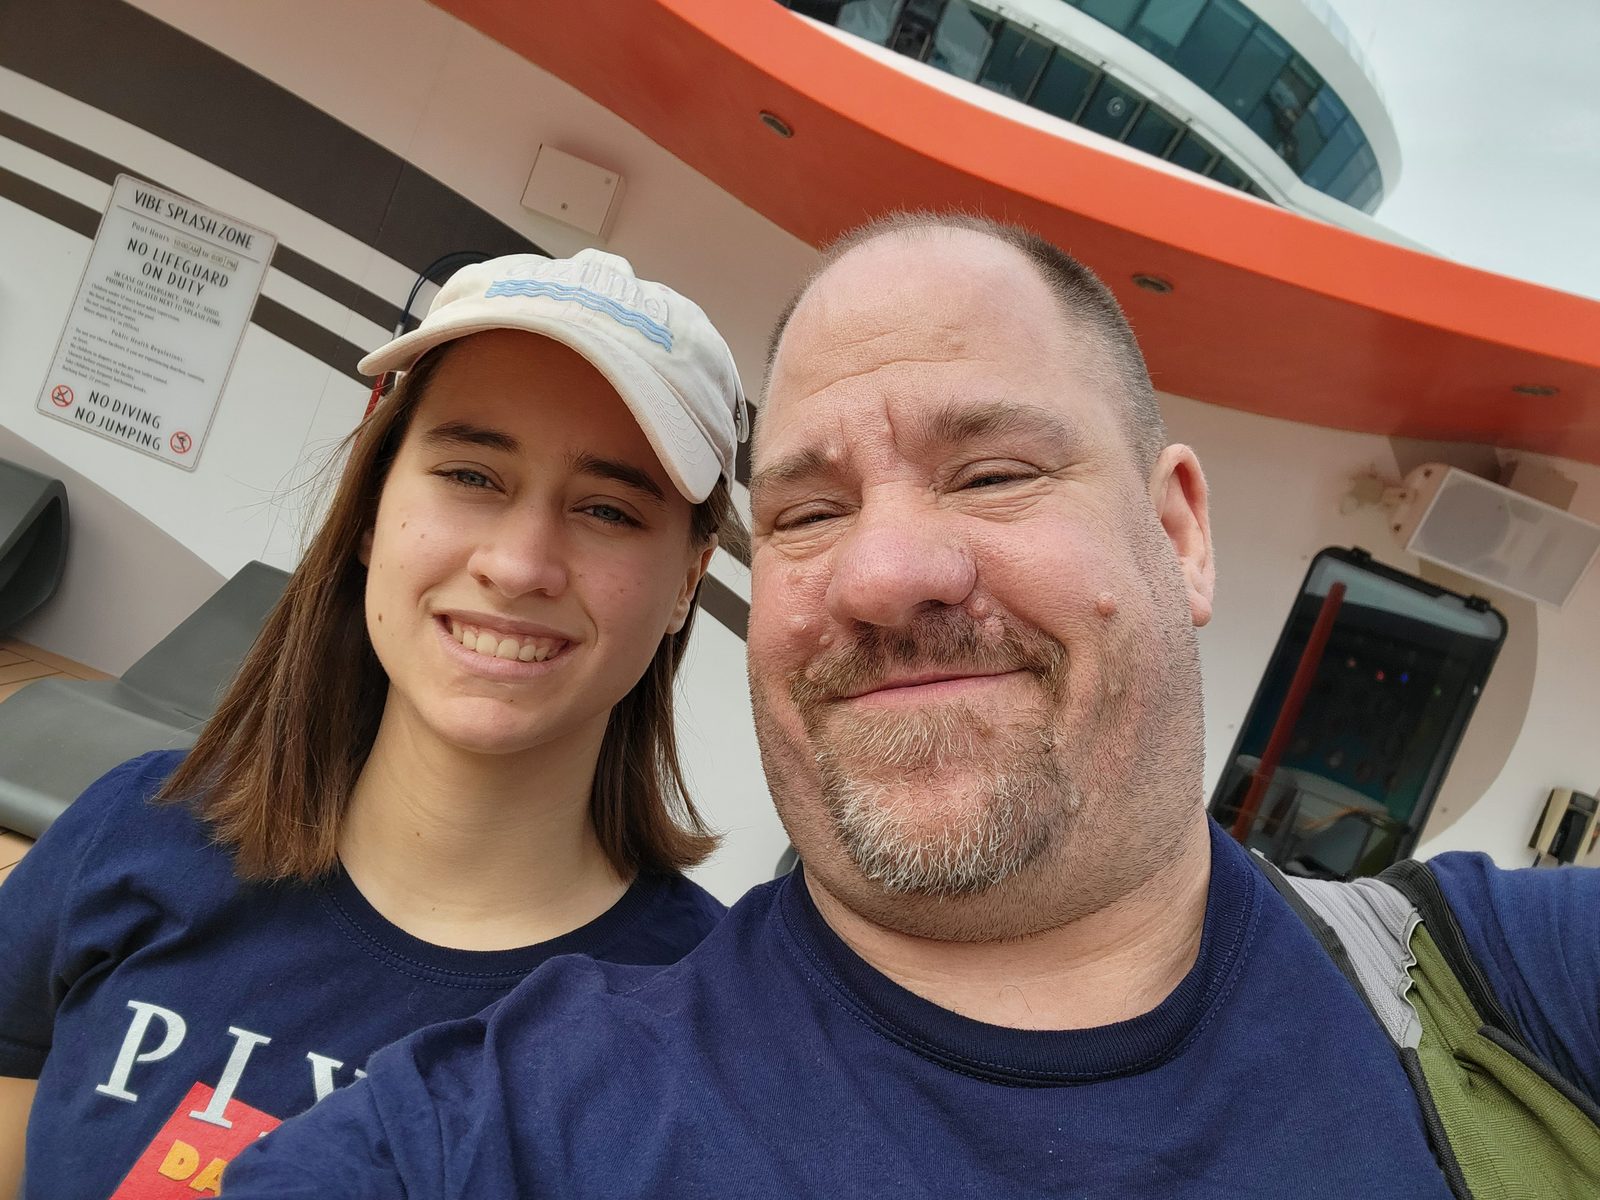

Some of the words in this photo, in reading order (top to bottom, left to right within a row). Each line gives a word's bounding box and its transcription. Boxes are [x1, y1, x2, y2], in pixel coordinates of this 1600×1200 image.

[135, 189, 164, 213] VIBE
[165, 202, 217, 235] SPLASH
[217, 223, 253, 249] ZONE
[121, 273, 135, 284] CASE
[127, 237, 148, 256] NO
[152, 247, 228, 287] LIFEGUARD
[141, 261, 163, 281] ON
[166, 271, 205, 296] DUTY
[74, 406, 96, 424] NO
[96, 415, 160, 451] JUMPING
[88, 390, 110, 408] NO
[111, 398, 160, 429] DIVING
